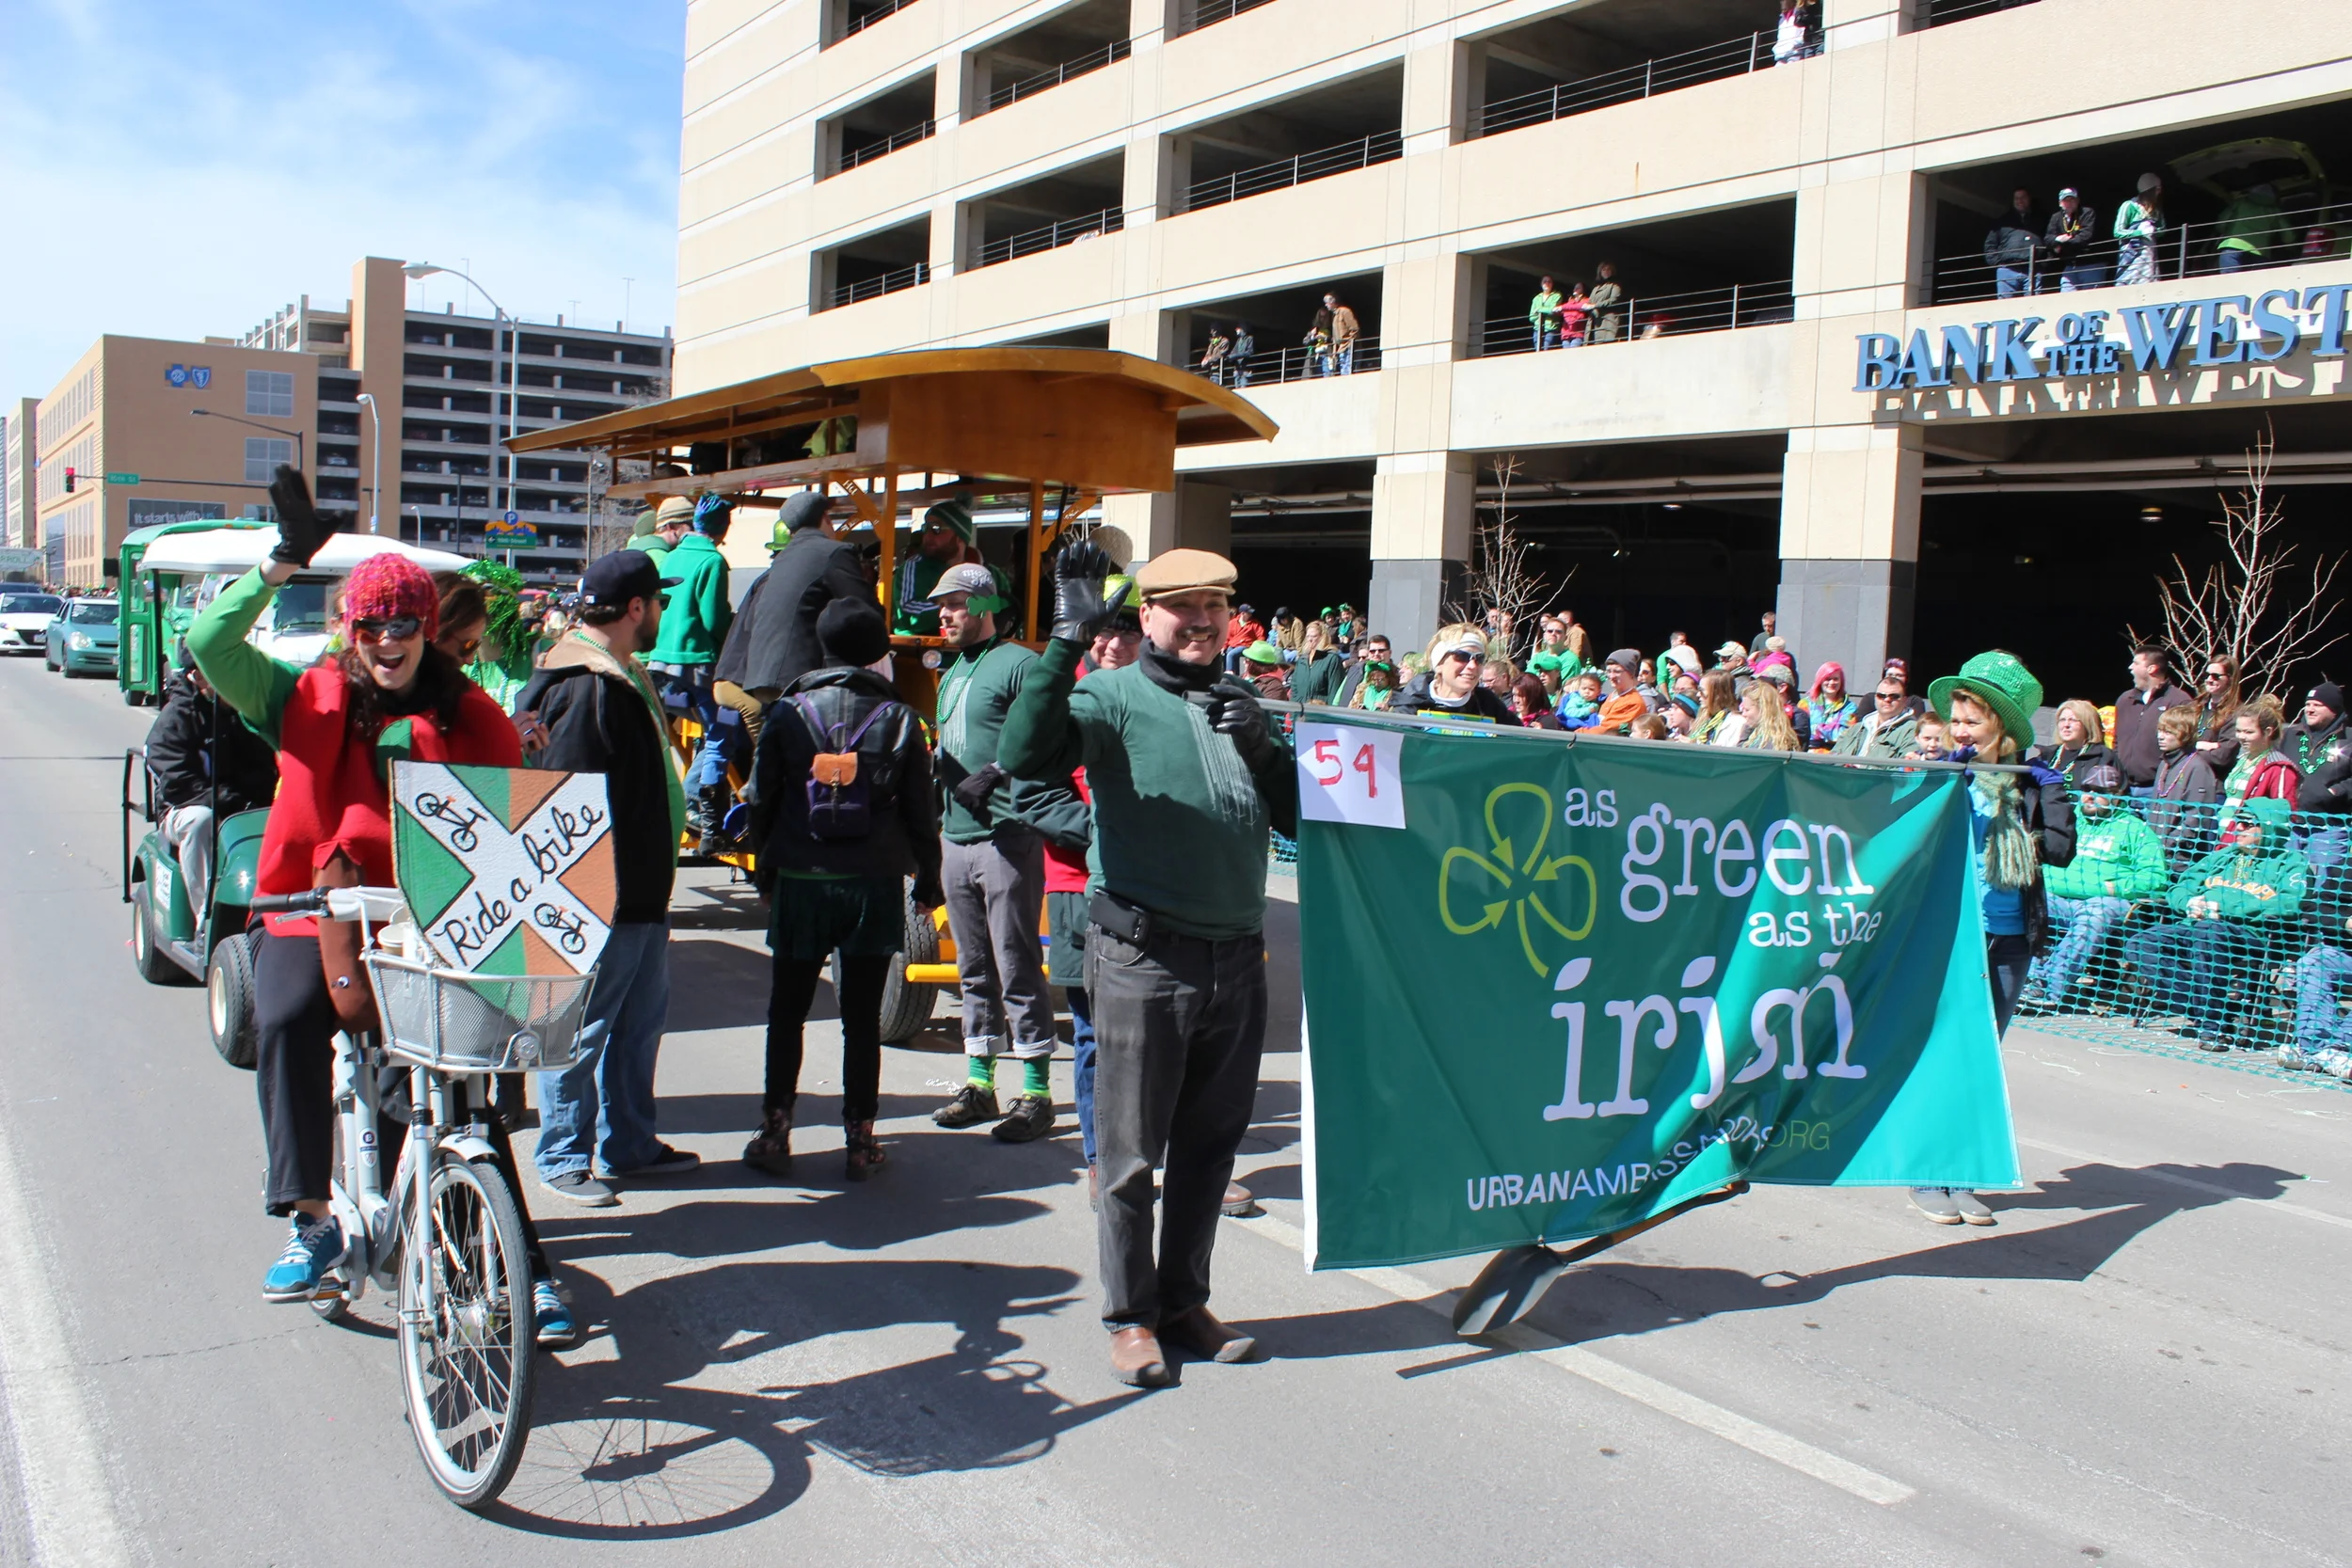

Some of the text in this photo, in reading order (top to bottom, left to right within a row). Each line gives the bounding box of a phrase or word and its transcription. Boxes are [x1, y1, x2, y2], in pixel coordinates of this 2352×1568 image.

[1852, 284, 2352, 392] BANK OF THE WEST
[1564, 787, 1619, 828] as
[434, 805, 603, 966] Ride a bike
[1620, 802, 1875, 923] green
[1748, 902, 1883, 947] as the
